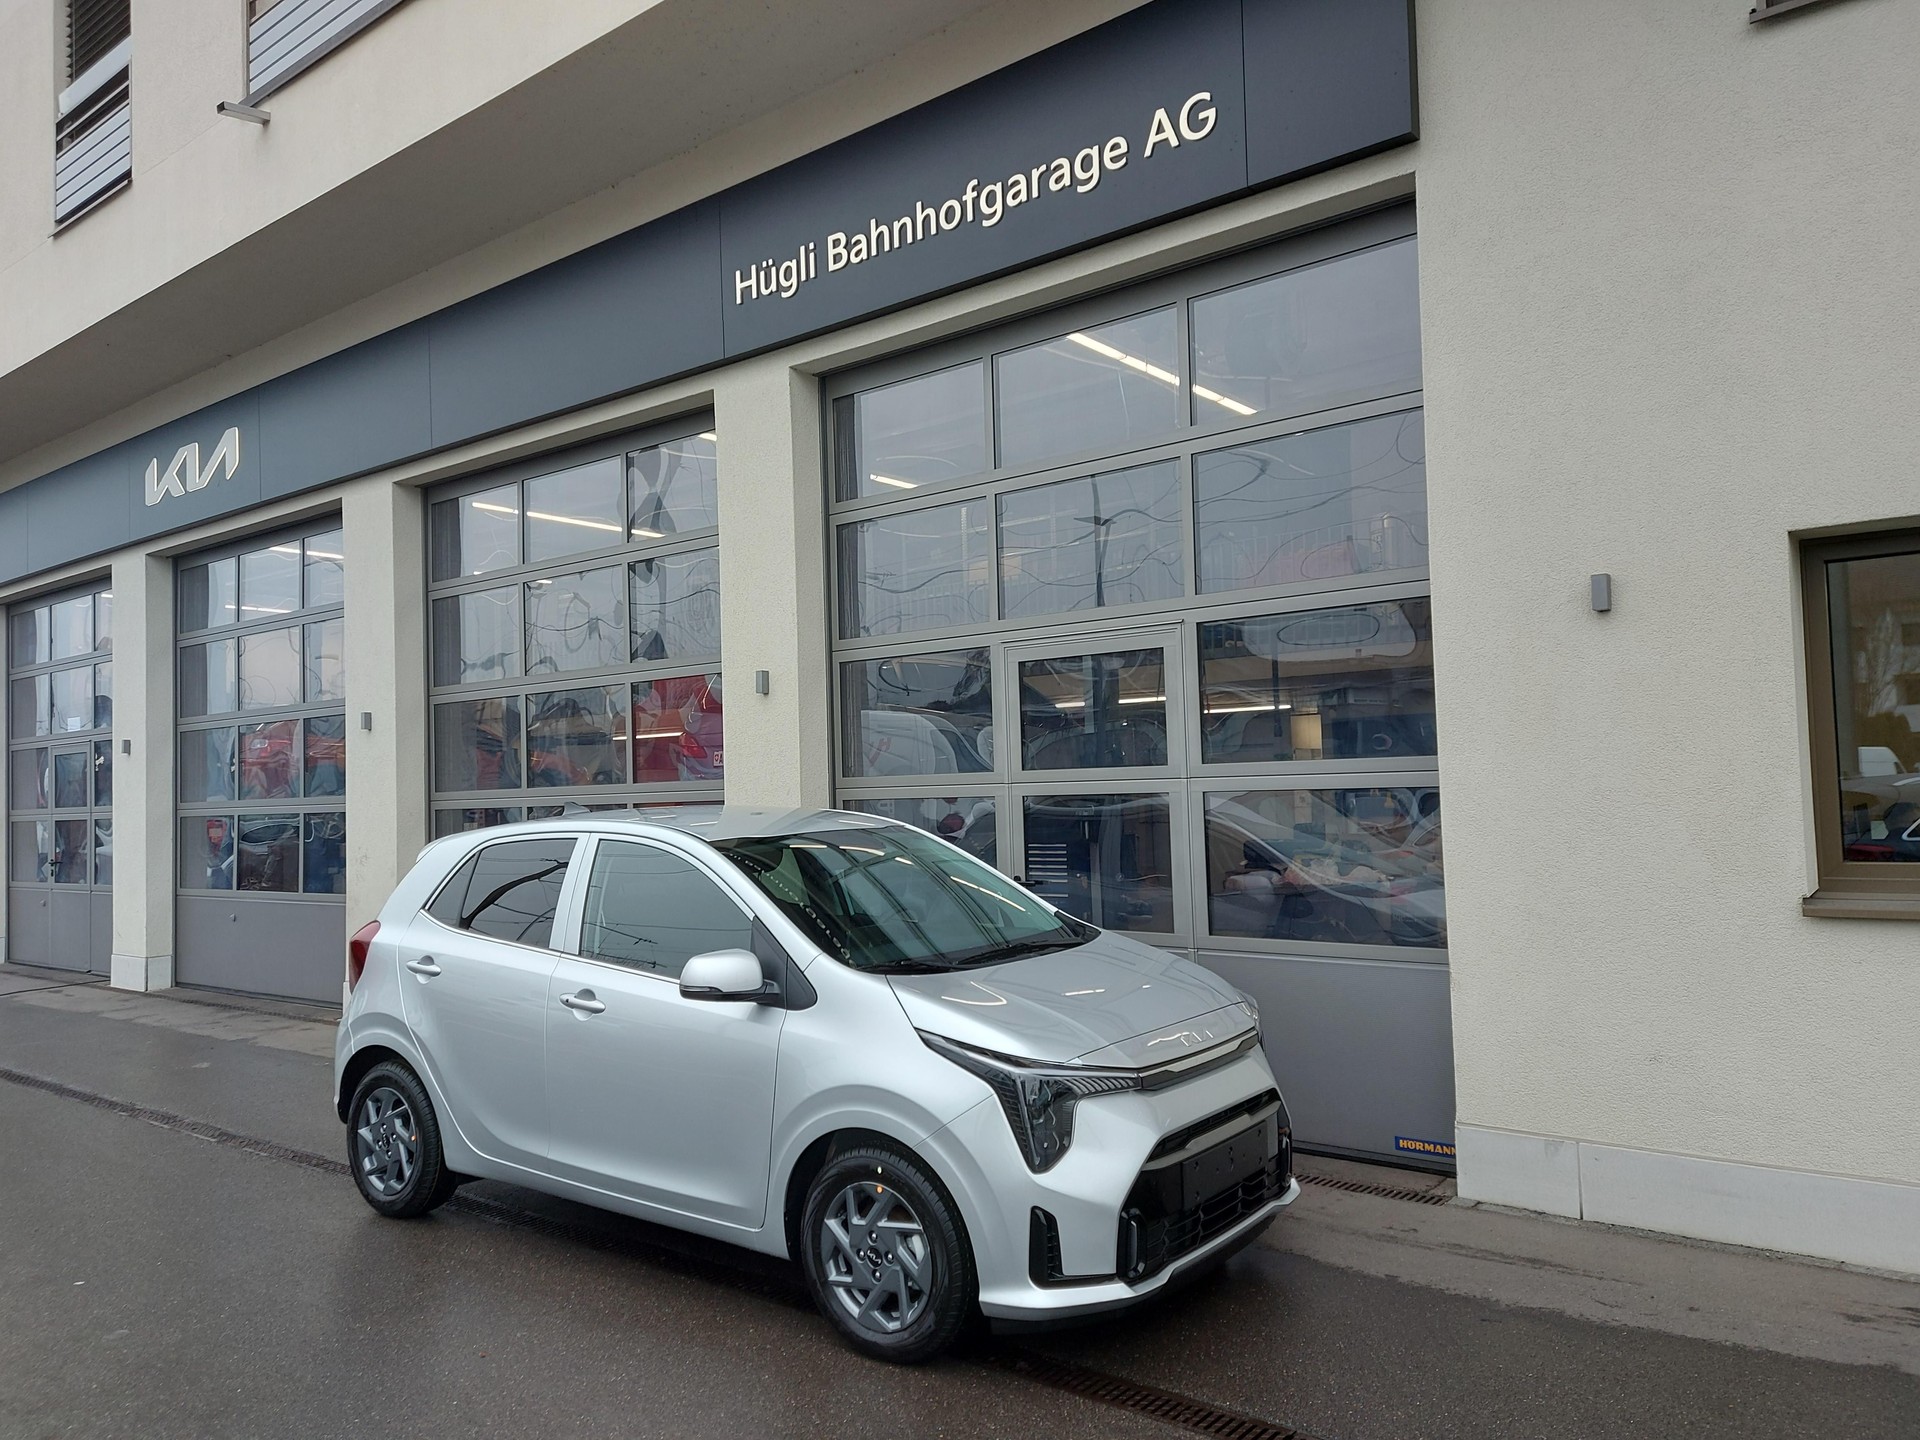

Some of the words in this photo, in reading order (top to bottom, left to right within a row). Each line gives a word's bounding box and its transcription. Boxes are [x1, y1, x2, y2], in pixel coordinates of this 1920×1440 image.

[735, 241, 815, 305] Hügli
[827, 136, 1128, 272] Bahnhofgarage
[1143, 91, 1217, 158] AG
[145, 426, 239, 507] KIA
